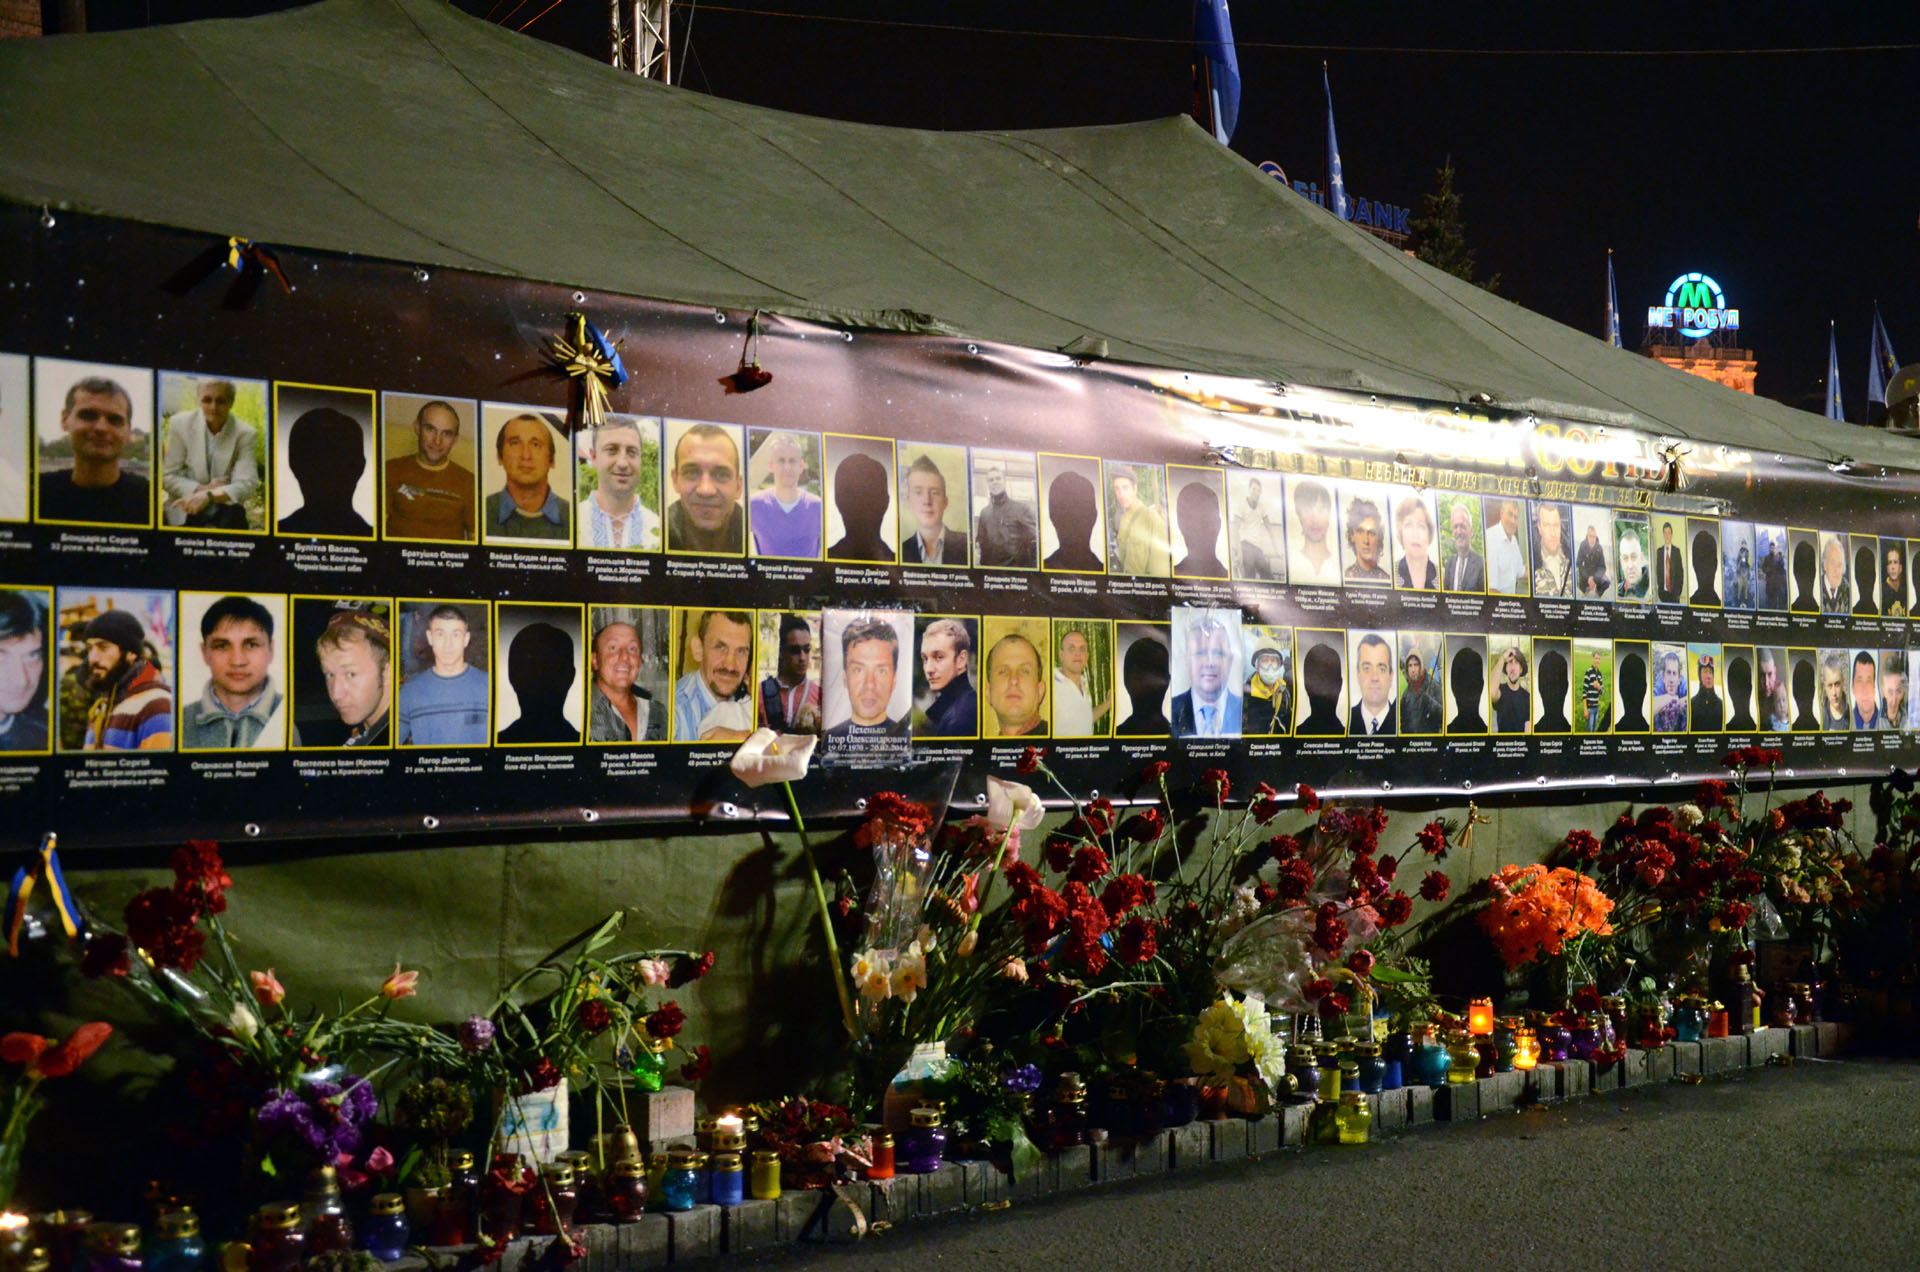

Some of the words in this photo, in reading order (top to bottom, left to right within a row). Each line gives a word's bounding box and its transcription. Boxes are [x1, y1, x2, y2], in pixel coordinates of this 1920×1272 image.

[1648, 306, 1739, 329] МЕТРОБУД
[1438, 469, 1478, 489] СОТНЯ
[1497, 477, 1529, 496] ХОЧЕ
[1589, 485, 1604, 502] НА
[206, 539, 255, 550] Володимир
[328, 544, 360, 554] Василь
[440, 551, 469, 559] Олексій
[514, 553, 539, 562] Богдан
[626, 558, 650, 566] Віталій
[698, 562, 719, 570] Роман
[828, 735, 846, 744] Ігор
[846, 735, 908, 744] Олександрович
[118, 758, 150, 768] Сергій
[418, 756, 440, 766] Пагор
[442, 756, 470, 765] Дмитро
[534, 754, 574, 763] Володимир
[236, 760, 269, 769] Валерій
